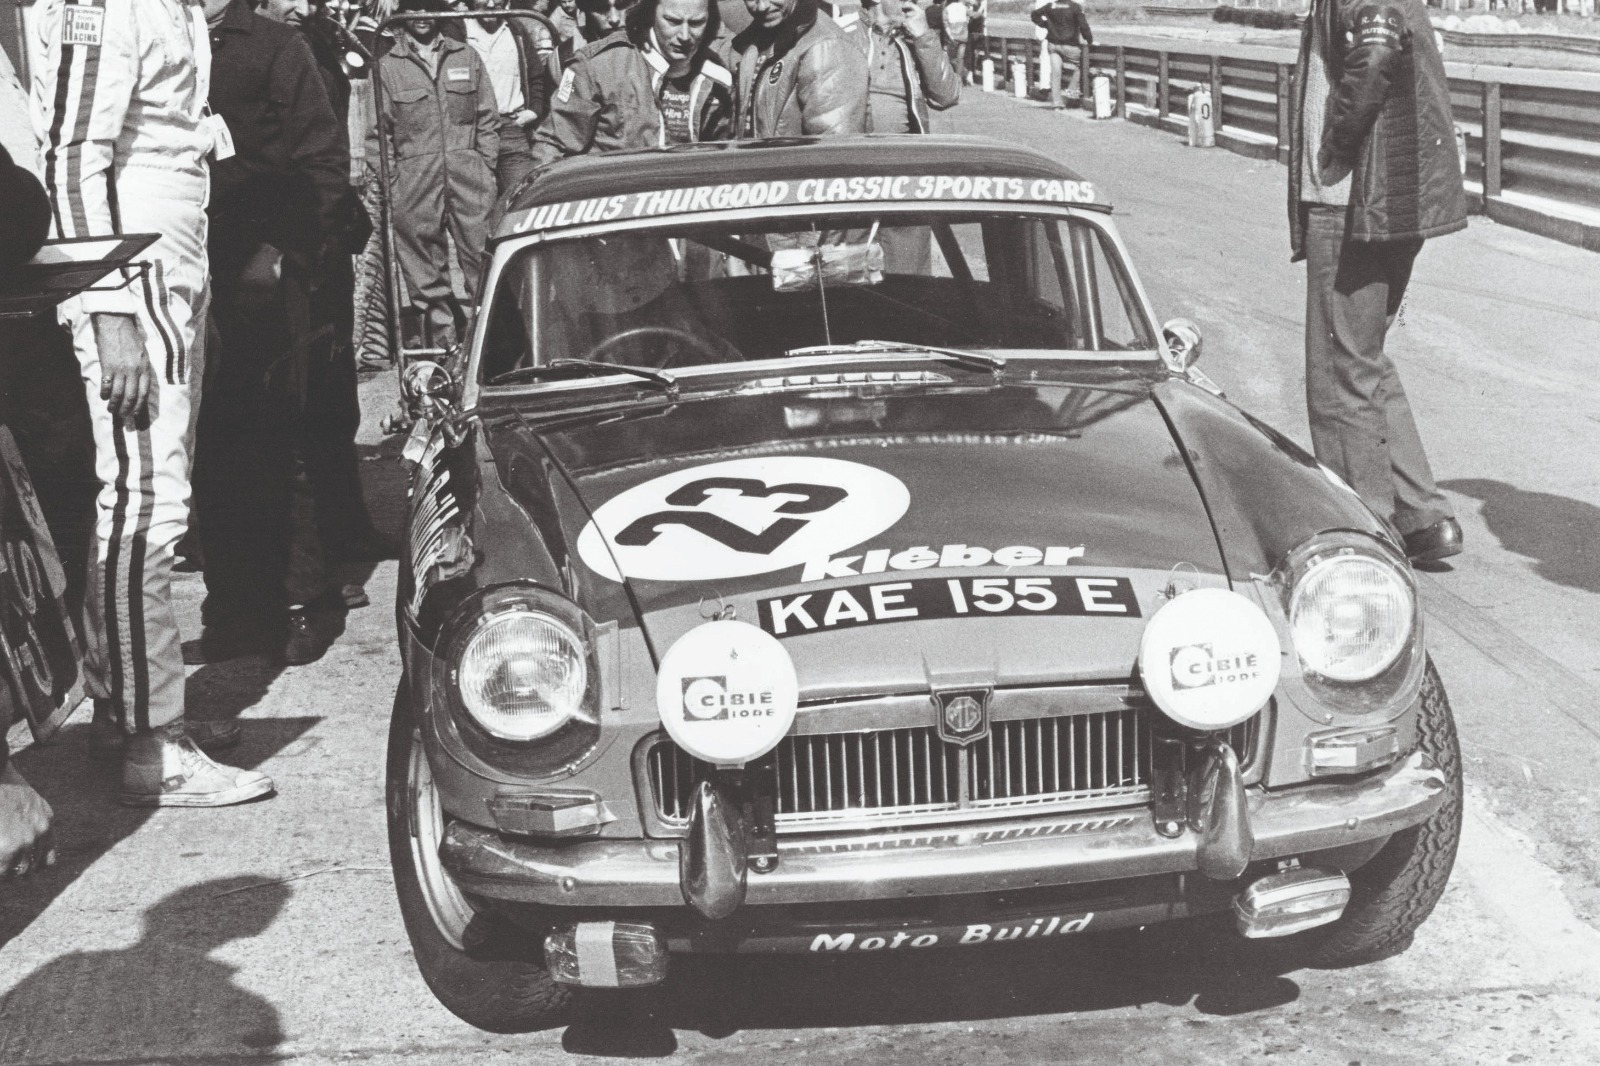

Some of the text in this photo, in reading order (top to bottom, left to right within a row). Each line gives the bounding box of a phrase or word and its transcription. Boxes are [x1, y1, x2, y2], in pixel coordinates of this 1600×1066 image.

[513, 175, 1095, 233] JULIUS THURGOOD CLASSIC SPORTS CARS
[614, 477, 849, 555] 23
[770, 578, 1127, 634] KAE 155 E
[701, 692, 773, 706] CIBIE
[732, 708, 775, 718] IODE
[948, 702, 979, 728] MG
[809, 912, 1095, 951] Moto Build
